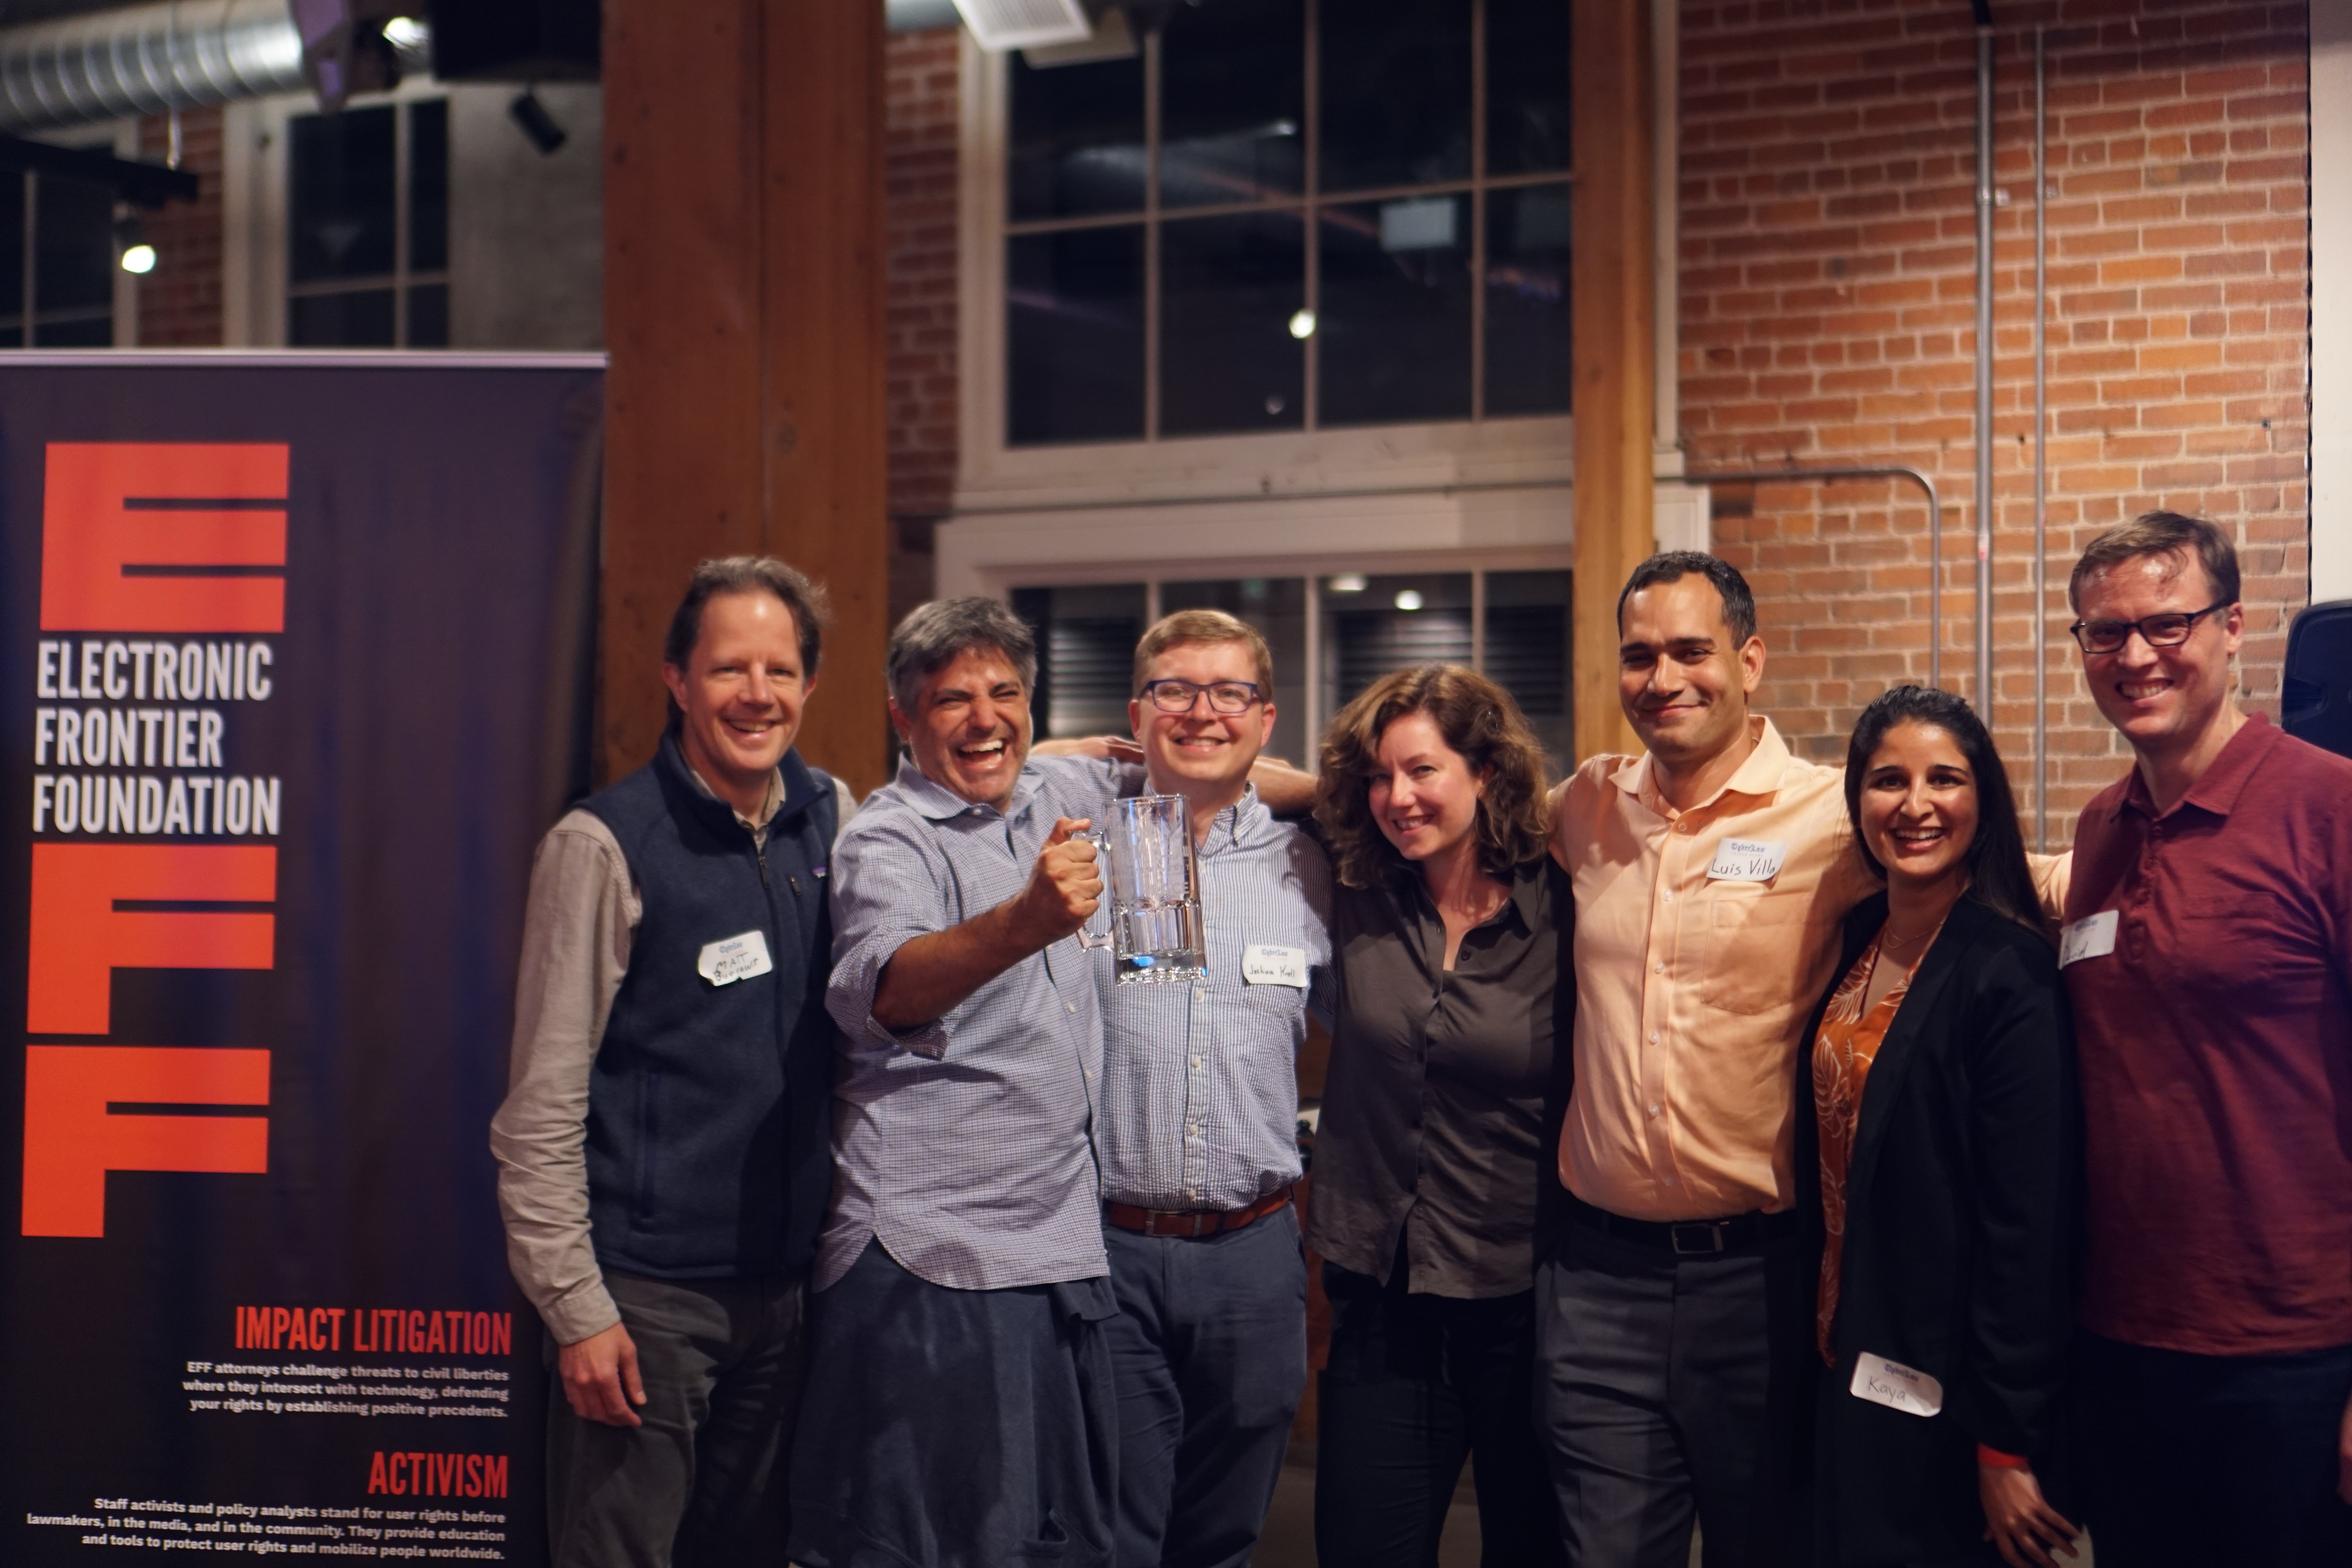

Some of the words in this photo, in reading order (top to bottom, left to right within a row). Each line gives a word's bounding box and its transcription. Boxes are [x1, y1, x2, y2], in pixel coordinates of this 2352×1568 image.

[40, 443, 289, 632] E
[38, 641, 272, 701] ELECTRONIC
[35, 708, 223, 767] FRONTIER
[33, 775, 280, 835] FOUNDATION
[1711, 857, 1741, 875] Luis
[1749, 858, 1775, 875] Villa
[27, 843, 277, 1034] F
[1249, 964, 1274, 975] Joshua
[22, 1045, 270, 1238] F
[236, 1306, 346, 1351] IMPACT
[354, 1309, 511, 1355] LITIGATION
[187, 1361, 213, 1373] EFF
[214, 1363, 280, 1377] attorneys
[281, 1363, 348, 1379] challenge
[350, 1365, 401, 1378] threats
[404, 1368, 419, 1378] to
[422, 1367, 450, 1379] civil
[454, 1368, 509, 1381] liberties
[182, 1379, 225, 1392] where
[227, 1380, 260, 1395] they
[261, 1381, 323, 1394] intersect
[325, 1382, 357, 1395] with
[359, 1384, 439, 1399] technology,
[442, 1386, 508, 1402] defending
[1868, 1376, 1906, 1403] Kaya
[189, 1400, 221, 1412] your
[223, 1398, 264, 1413] rights
[266, 1399, 283, 1414] by
[285, 1401, 369, 1416] establishing
[372, 1403, 425, 1416] positive
[428, 1405, 508, 1417] precedents.
[368, 1451, 508, 1498] ACTIVISM
[94, 1498, 129, 1510] Staff
[130, 1500, 186, 1513] activists
[188, 1503, 214, 1514] and
[216, 1503, 258, 1518] policy
[260, 1505, 317, 1519] analysts
[321, 1507, 359, 1518] stand
[363, 1507, 383, 1519] for
[386, 1511, 416, 1519] user
[419, 1509, 459, 1523] rights
[462, 1510, 505, 1523] before
[27, 1513, 105, 1528] lawmakers,
[108, 1516, 121, 1527] in
[123, 1517, 146, 1528] the
[149, 1519, 192, 1532] media,
[194, 1521, 220, 1532] and
[223, 1521, 237, 1533] in
[239, 1522, 263, 1534] the
[265, 1524, 345, 1539] community.
[348, 1525, 382, 1540] They
[385, 1527, 435, 1540] provide
[439, 1528, 505, 1541] education
[82, 1534, 107, 1544] and
[109, 1535, 144, 1546] tools
[146, 1537, 161, 1547] to
[163, 1539, 212, 1550] protect
[215, 1542, 246, 1551] user
[248, 1540, 287, 1555] rights
[290, 1542, 316, 1553] and
[319, 1543, 377, 1555] mobilize
[380, 1545, 426, 1559] people
[429, 1547, 504, 1559] worldwide.
